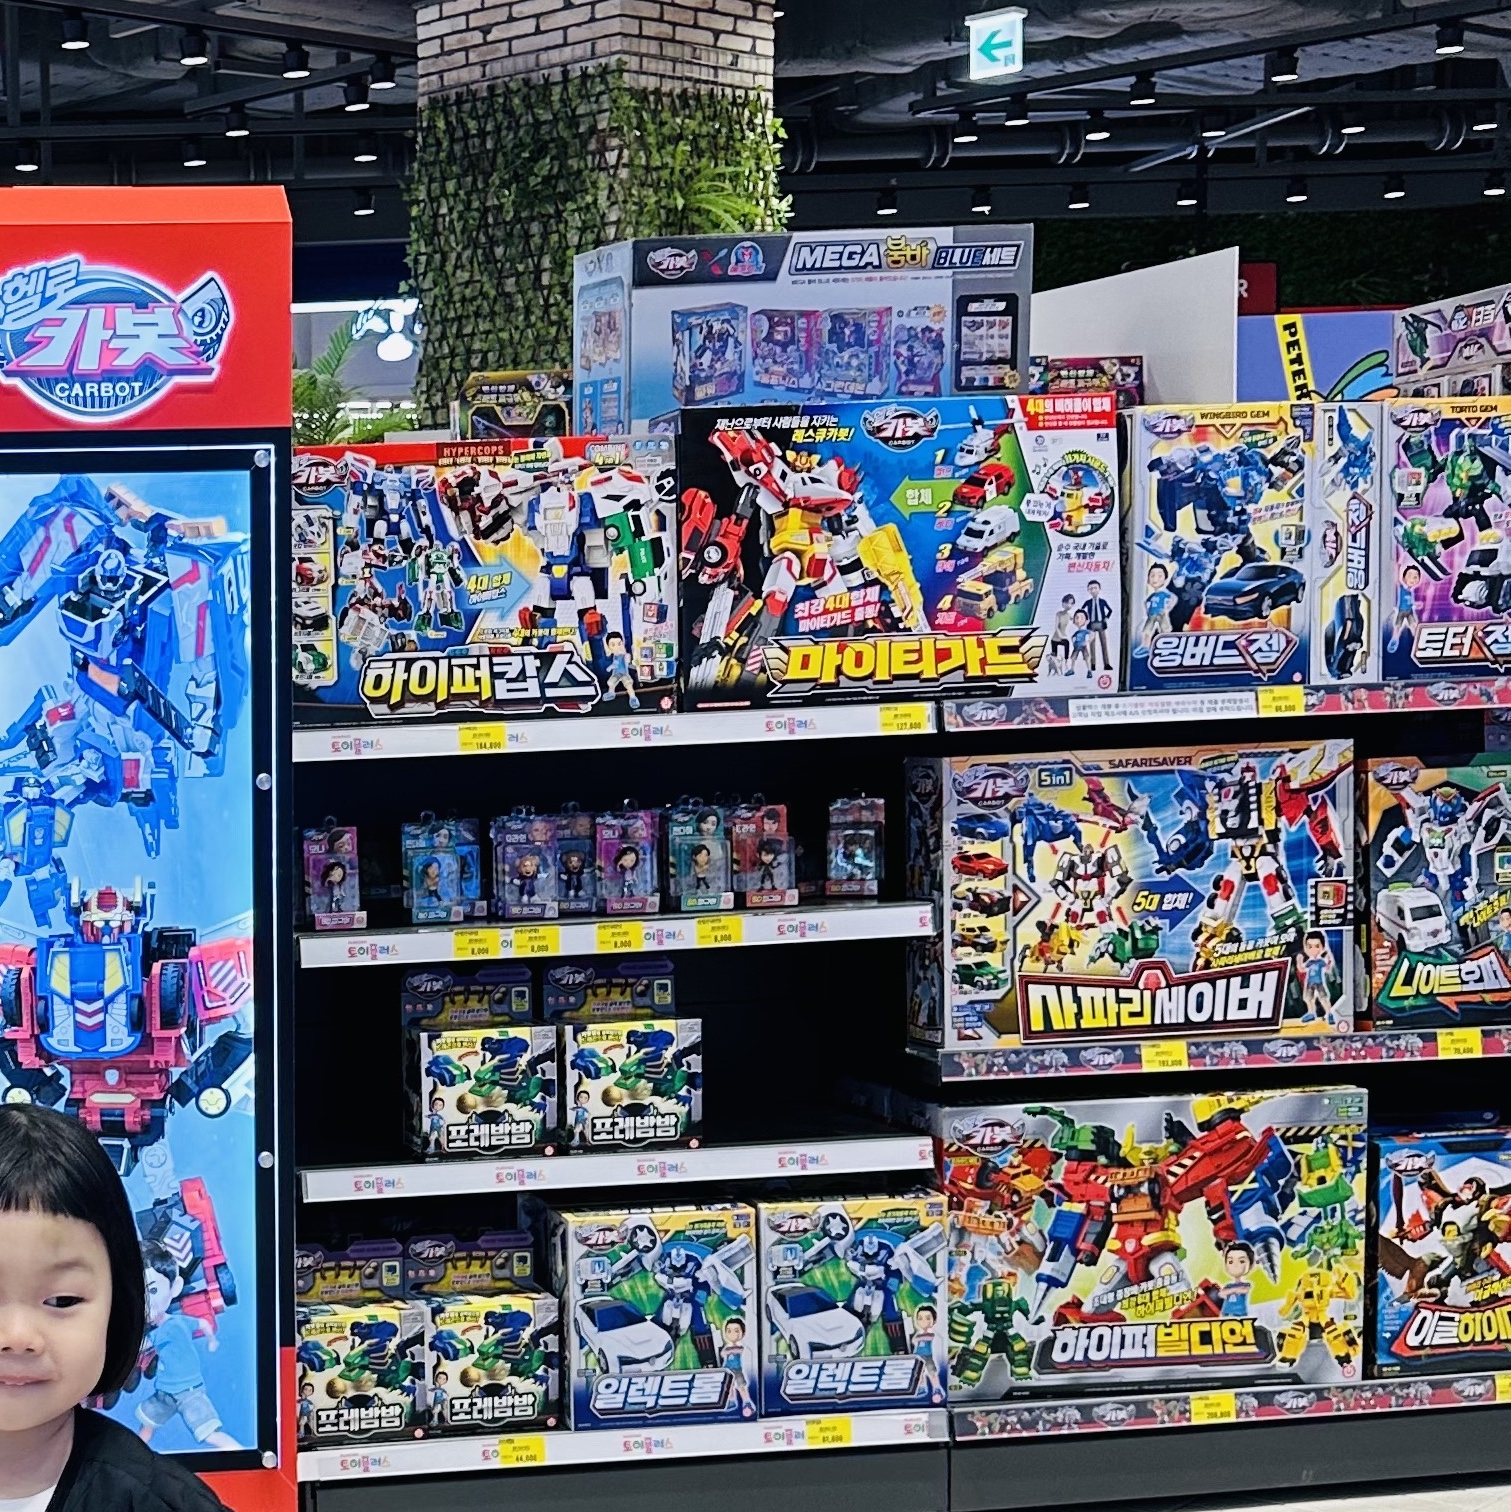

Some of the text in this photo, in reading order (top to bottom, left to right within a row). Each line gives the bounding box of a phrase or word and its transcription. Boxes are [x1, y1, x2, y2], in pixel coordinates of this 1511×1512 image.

[796, 243, 881, 269] MEGA
[885, 236, 930, 269] 붐바
[1, 259, 80, 325] 헬로
[19, 303, 202, 370] 카봇
[54, 381, 145, 398] CARBOT
[1251, 410, 1270, 419] GEM
[877, 413, 936, 439] 카봇
[443, 445, 505, 457] HYPERCOPS
[905, 487, 933, 506] 합체
[783, 635, 1029, 683] 마이티가드
[363, 653, 598, 705] 하이퍼캅스
[621, 724, 673, 741] 토이플러스
[765, 717, 817, 734] 토이플러스
[1108, 756, 1193, 769] SAFARISAVER
[970, 776, 1025, 799] 카봇
[1039, 772, 1071, 787] 5in1
[644, 928, 685, 946] 이플러스
[777, 920, 828, 937] 토이플러스
[348, 943, 399, 960] 토이플러스
[1027, 970, 1279, 1032] 사파리세이버
[447, 1122, 533, 1147] 포레밤밤
[592, 1114, 678, 1138] 포레밤밤
[637, 1161, 688, 1178] 토이플러스
[778, 1153, 829, 1170] 토이플러스
[354, 1176, 405, 1194] 토이플러스
[495, 1168, 547, 1186] 토이플러스
[1051, 1318, 1258, 1363] 하이퍼빌디언
[450, 1395, 536, 1422] 포레밤밤
[317, 1405, 403, 1432] 포레밤밤
[623, 1437, 674, 1454] 토이플러스
[764, 1428, 805, 1446] 토이플러
[340, 1455, 391, 1473] 토이플러스
